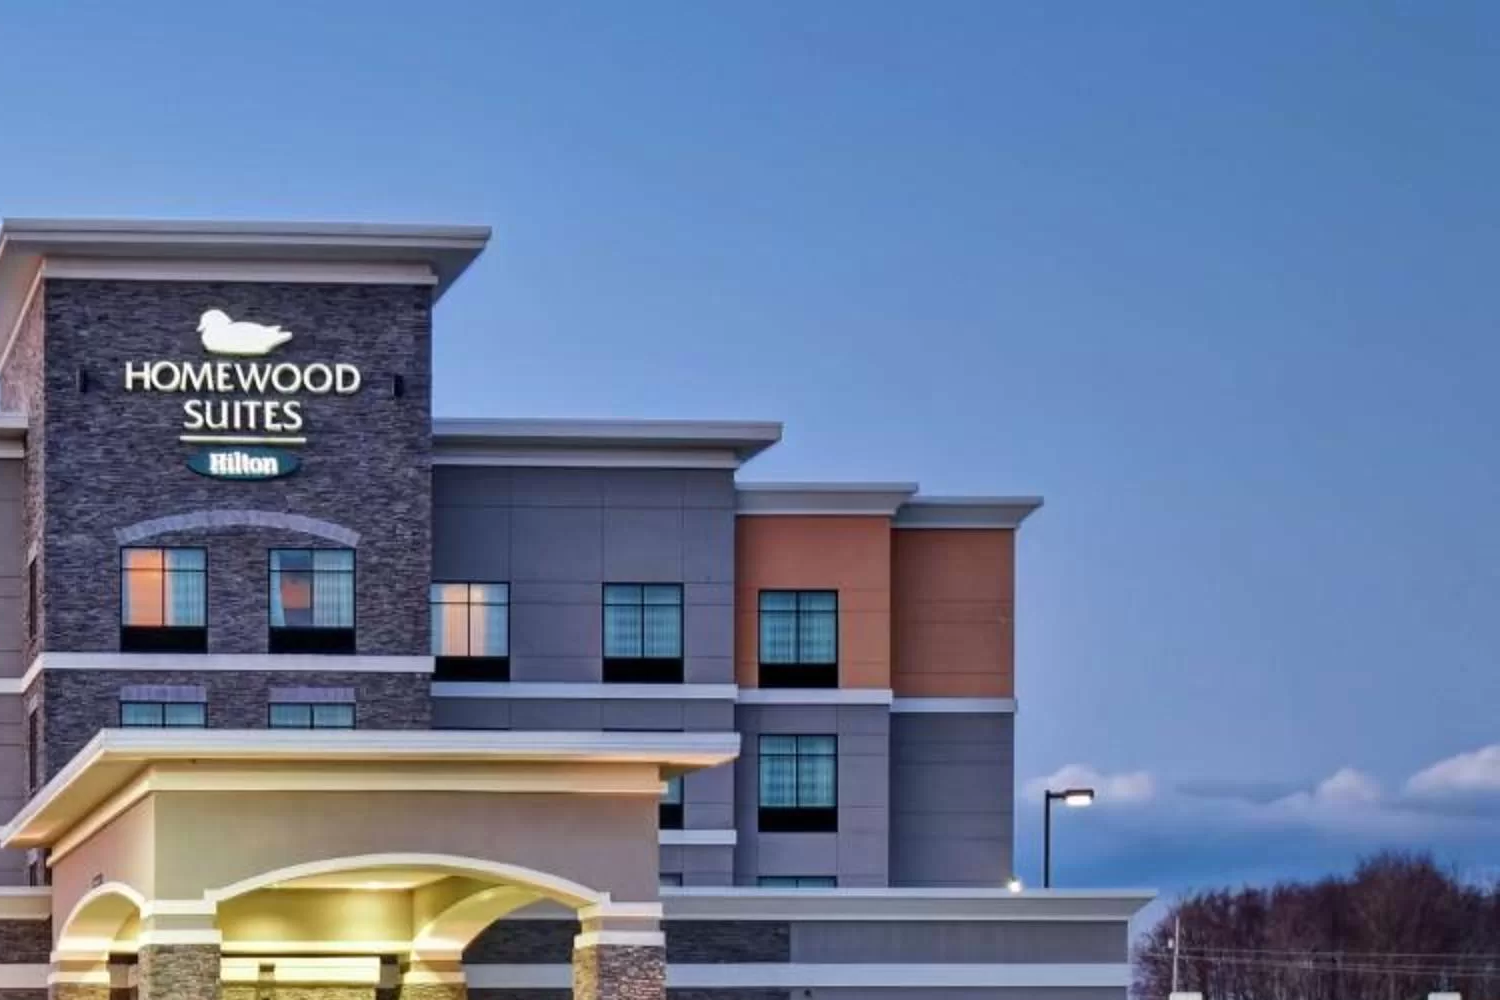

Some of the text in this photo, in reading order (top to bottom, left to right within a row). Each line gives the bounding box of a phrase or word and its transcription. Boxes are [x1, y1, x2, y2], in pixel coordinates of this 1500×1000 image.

[124, 360, 361, 393] HOMEWOOD
[183, 399, 303, 431] SUITES
[209, 451, 278, 475] Hilton
